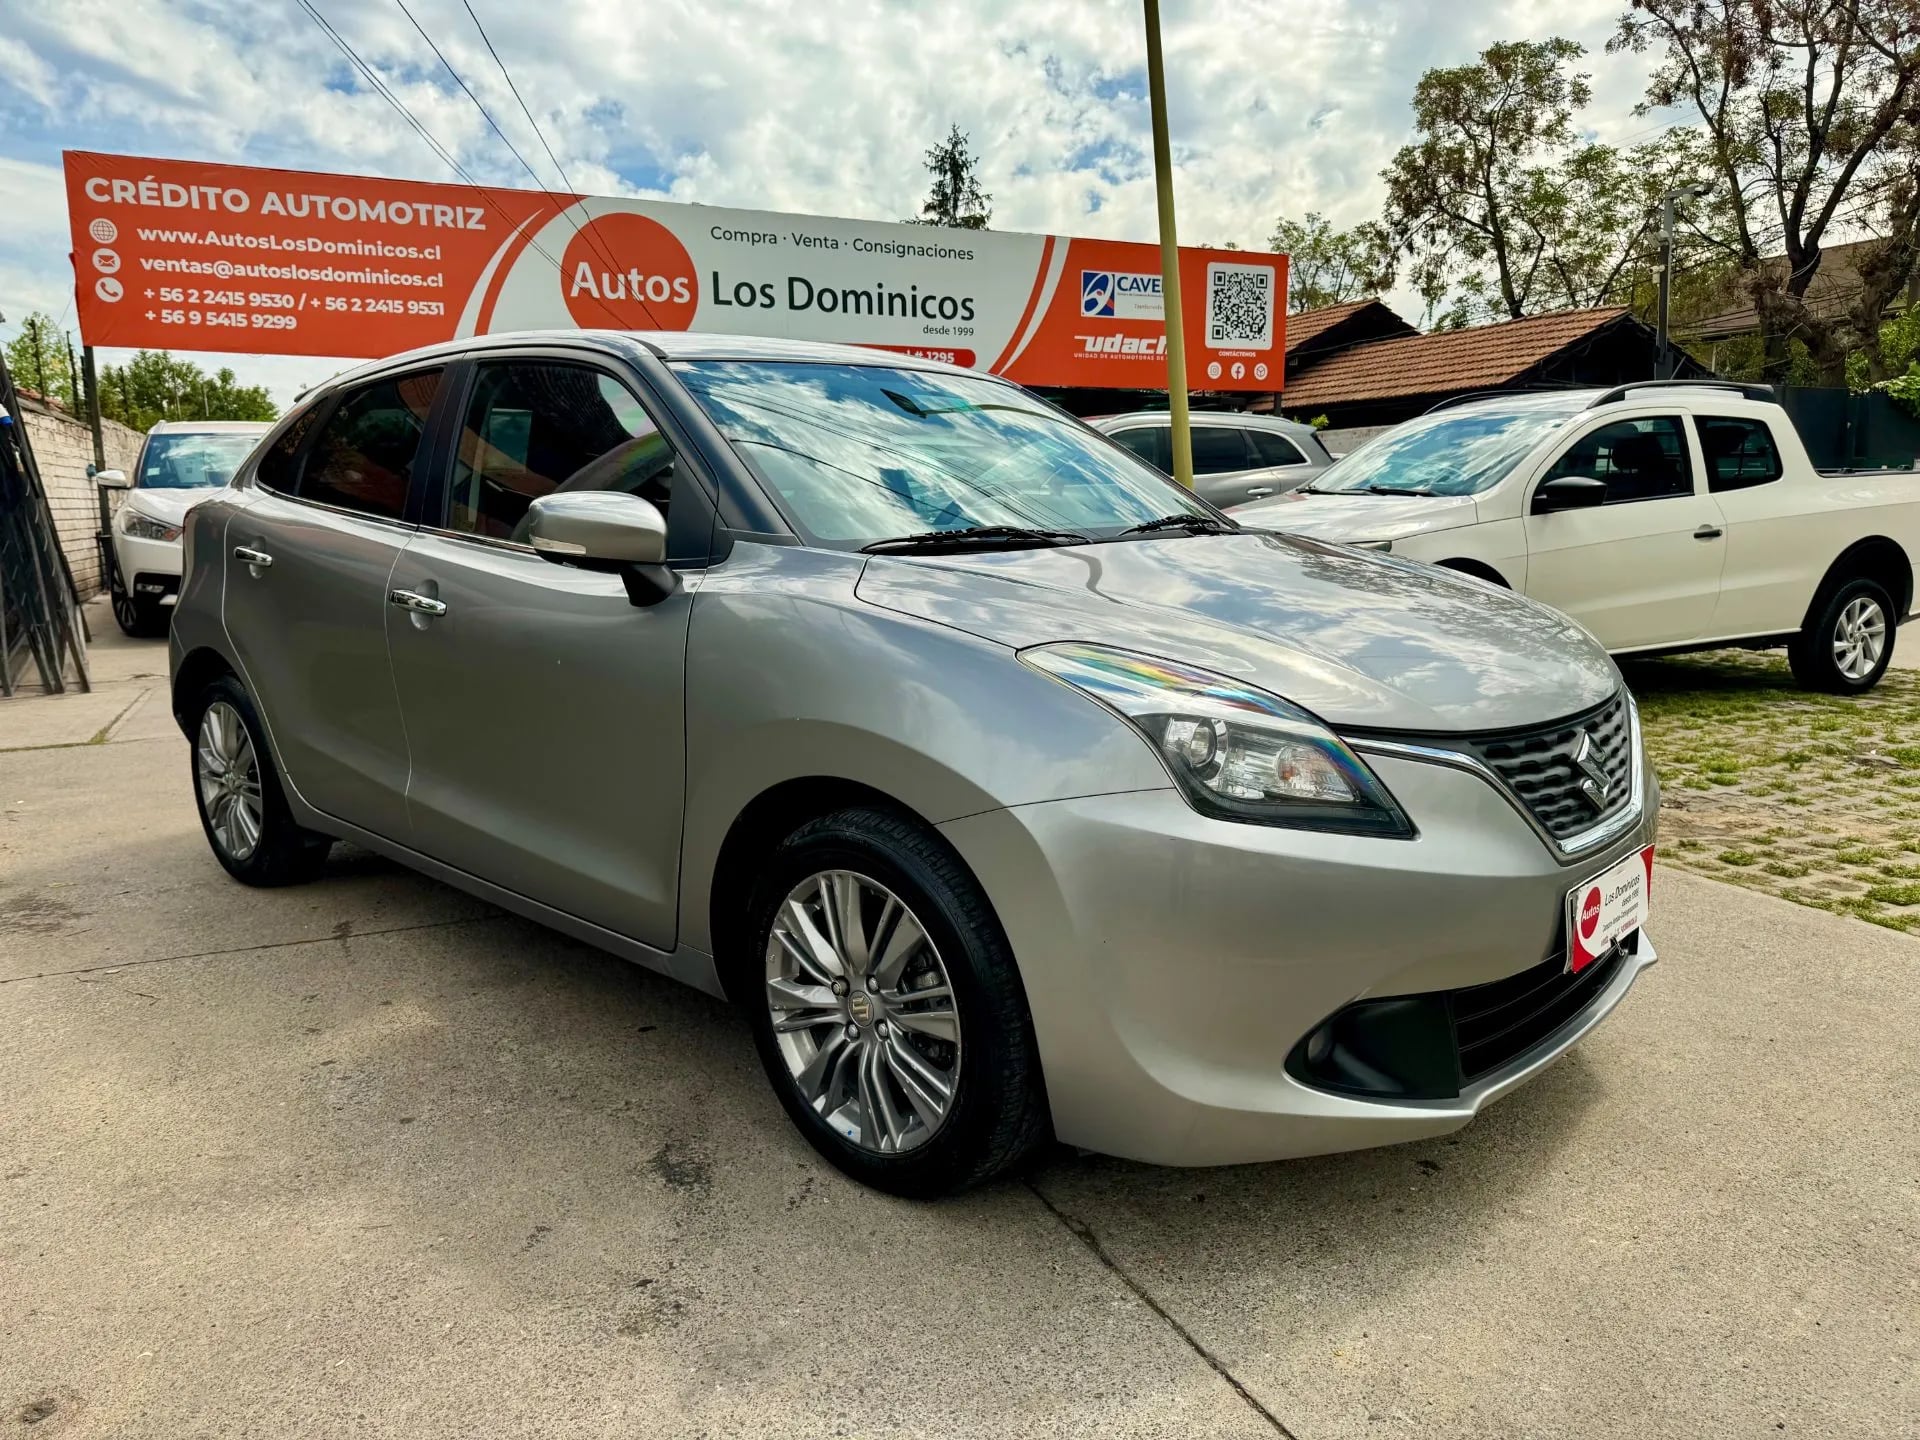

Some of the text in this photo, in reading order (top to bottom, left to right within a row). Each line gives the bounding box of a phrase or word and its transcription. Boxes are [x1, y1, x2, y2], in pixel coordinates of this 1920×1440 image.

[85, 175, 486, 230] CRÉDITO AUTOMOTRIZ
[137, 227, 441, 260] www.AutosLosDominicos.cl
[710, 226, 974, 262] Compra Venta Consignaciones
[140, 256, 443, 288] ventas@autoslosdominicos.cl
[570, 261, 691, 305] Autos
[1117, 276, 1164, 293] CAVE
[159, 287, 184, 302] 56
[187, 289, 200, 303] 2
[203, 290, 245, 305] 2415
[249, 293, 295, 308] 9530
[325, 297, 348, 311] 56
[351, 298, 362, 312] 2
[365, 299, 404, 313] 2415
[407, 301, 444, 315] 9531
[712, 271, 975, 321] Los Dominicos
[161, 309, 185, 324] 56
[189, 311, 202, 325] 9
[206, 311, 248, 327] 5415
[251, 314, 297, 329] 9299
[923, 325, 974, 336] desde 1999
[926, 351, 955, 363] 1295
[1582, 904, 1600, 920] Autos
